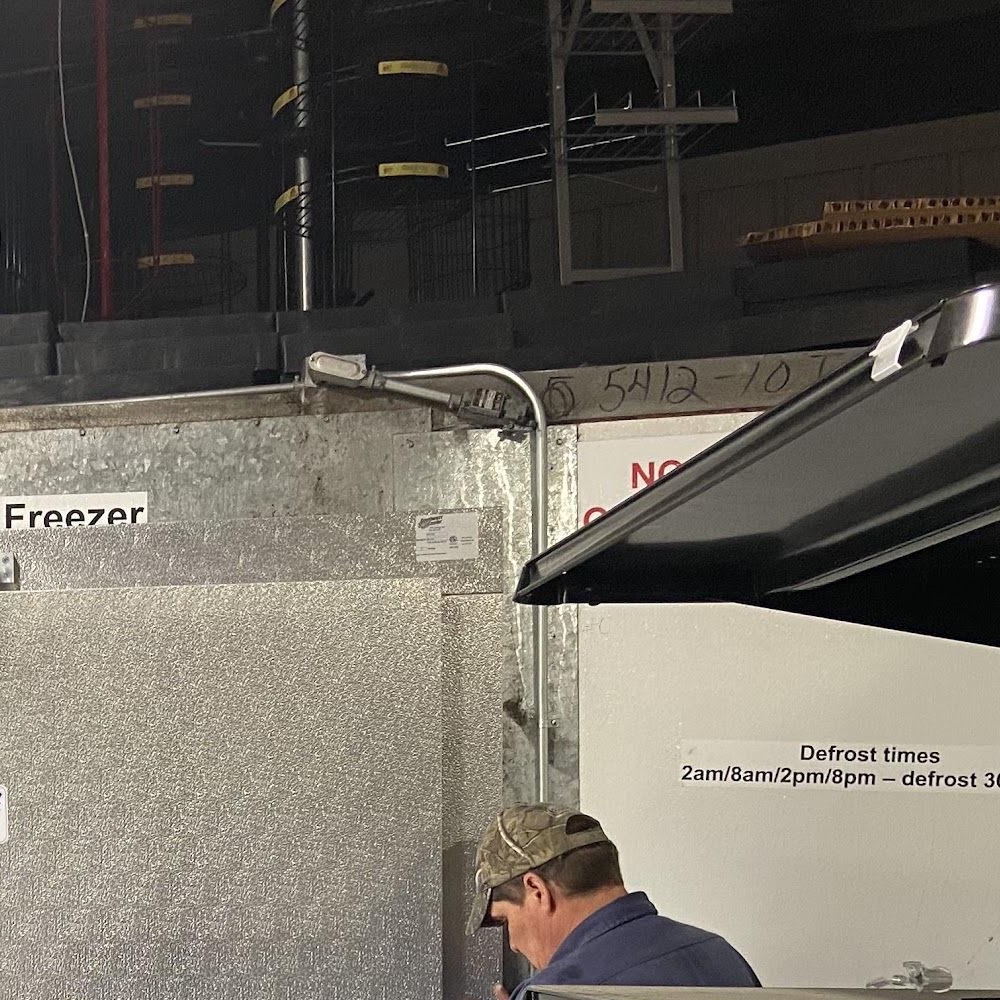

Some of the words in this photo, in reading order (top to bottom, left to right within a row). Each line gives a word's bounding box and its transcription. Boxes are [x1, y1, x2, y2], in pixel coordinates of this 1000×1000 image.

[5, 503, 145, 529] Freezer
[799, 744, 878, 763] Defrost
[883, 746, 941, 764] times
[680, 765, 876, 788] 2am/8am/2pm/8pm
[901, 770, 978, 788] defrost
